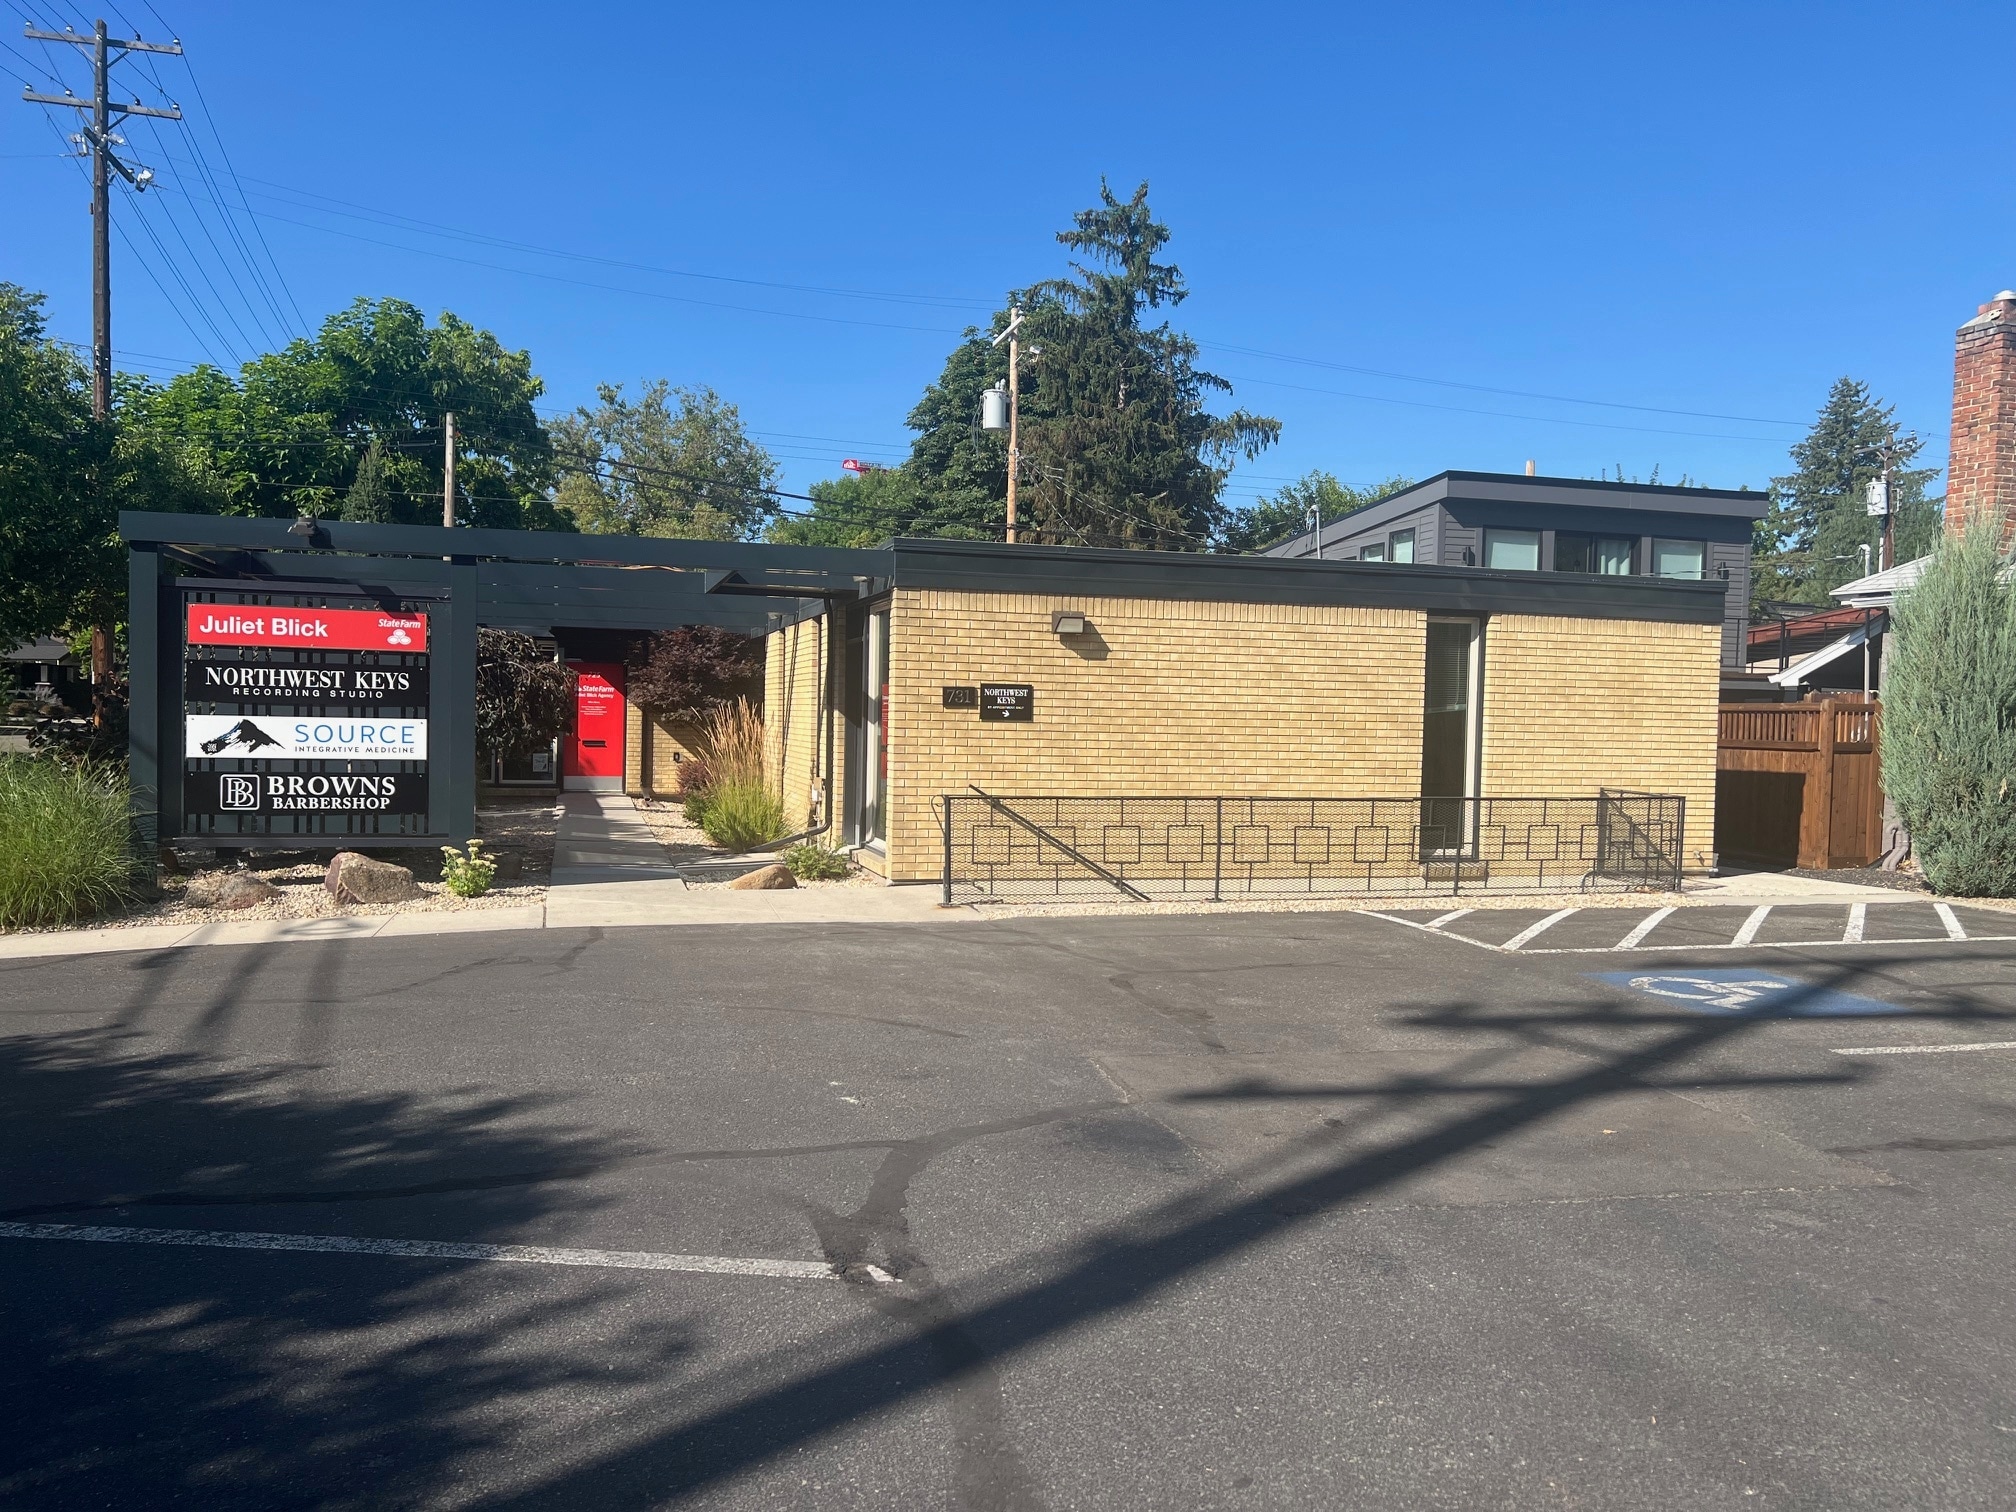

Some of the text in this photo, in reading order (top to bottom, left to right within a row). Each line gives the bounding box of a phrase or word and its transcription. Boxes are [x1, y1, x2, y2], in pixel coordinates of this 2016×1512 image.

[200, 615, 329, 637] Juliet Blick
[205, 666, 410, 690] NORTHWEST KEYS
[233, 687, 384, 699] RECORDING STUDIO
[946, 689, 971, 703] 731
[984, 688, 1029, 697] NORTHWEST
[997, 696, 1016, 705] KEYS
[295, 724, 415, 744] SOURCE
[294, 745, 415, 754] INTEGRATIVE MEDICINE
[266, 776, 396, 796] BROWNS
[272, 797, 391, 810] BARBERSHOP
